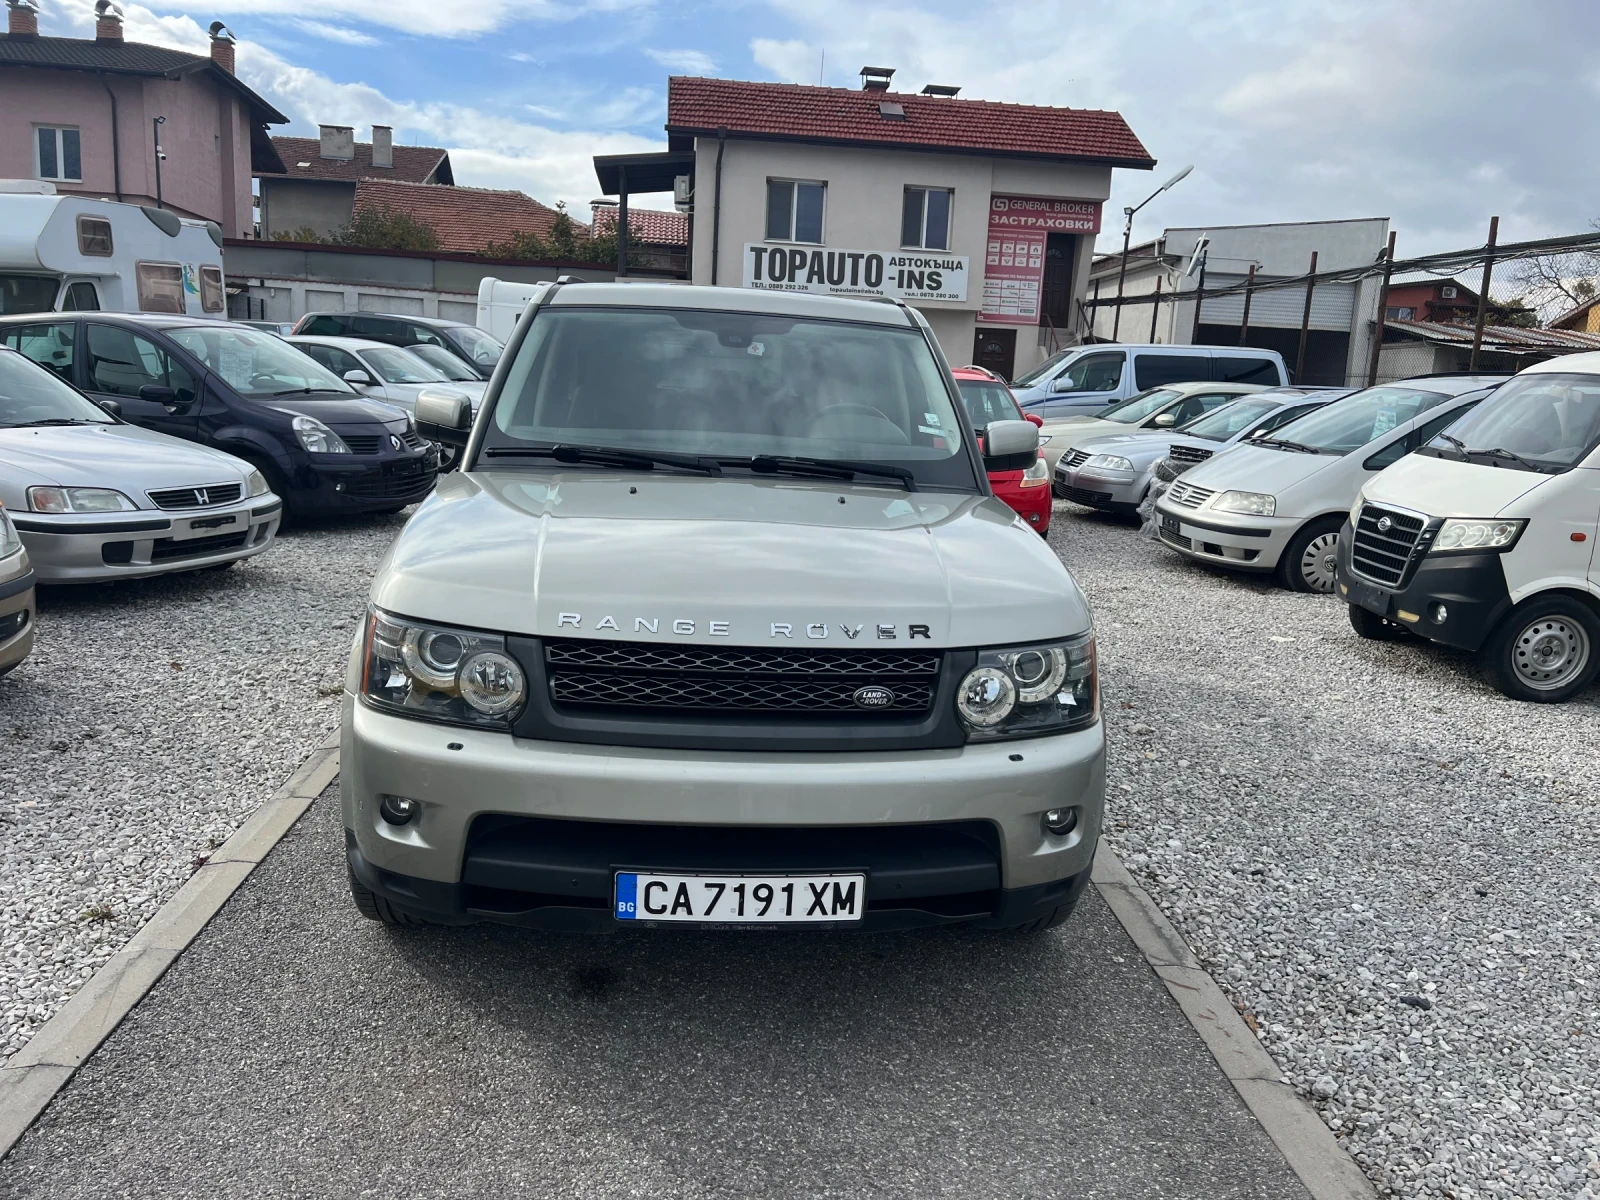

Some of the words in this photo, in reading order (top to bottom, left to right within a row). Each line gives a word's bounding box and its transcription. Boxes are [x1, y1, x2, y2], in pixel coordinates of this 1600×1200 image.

[1010, 200, 1051, 212] GENERAL
[1054, 202, 1095, 214] BROKER
[991, 215, 1094, 230] ЗАСТРАХОВКИ
[749, 246, 884, 288] TOPAUTO
[888, 256, 964, 272] АВТОКЪЩА
[557, 612, 731, 637] RANGE
[769, 622, 932, 640] ROVER
[618, 901, 635, 913] BG
